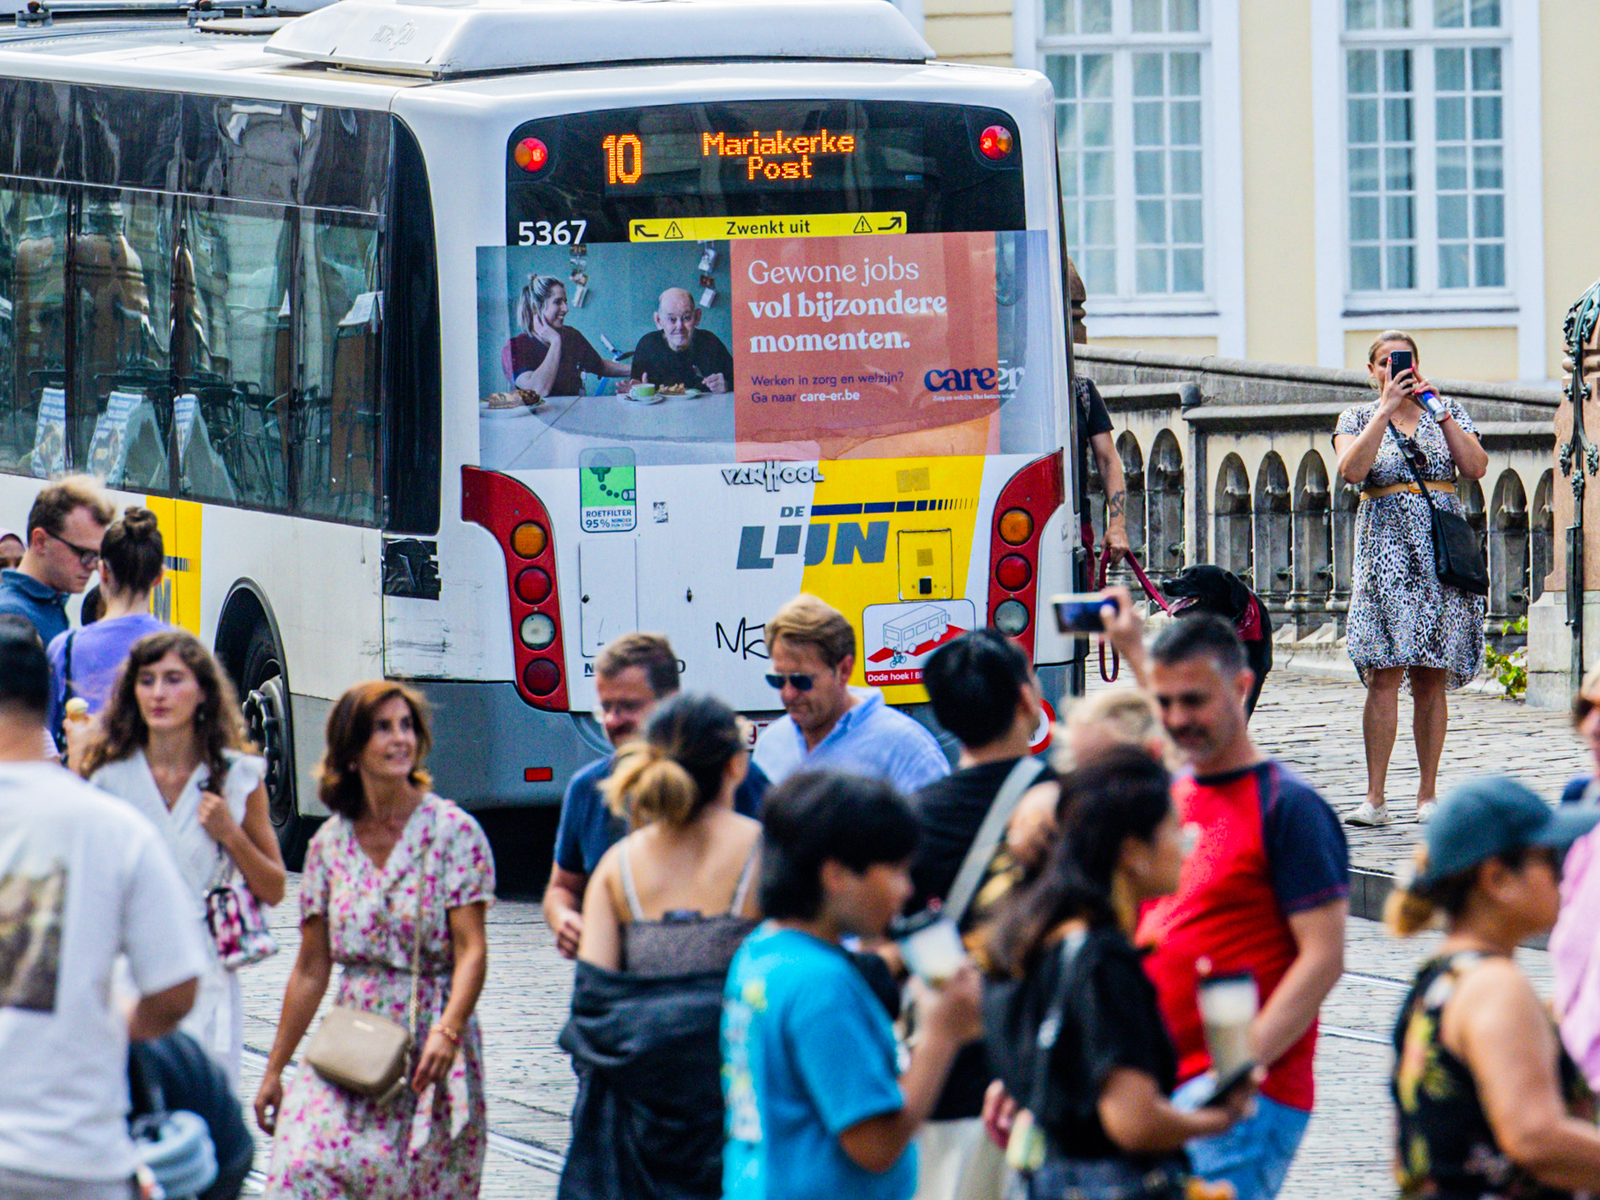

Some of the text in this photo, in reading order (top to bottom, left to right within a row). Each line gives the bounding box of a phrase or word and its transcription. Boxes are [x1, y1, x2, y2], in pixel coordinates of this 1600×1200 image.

[702, 128, 855, 156] Mariakerke
[602, 133, 642, 184] 10
[748, 154, 812, 180] Post
[518, 219, 588, 246] 5367
[726, 219, 810, 236] Zwenkt uit
[748, 255, 920, 287] Gewone jobs
[748, 288, 948, 323] vol bijzondere
[749, 329, 911, 353] momenten.
[751, 371, 904, 387] Werken in zorg en welzijn?
[751, 389, 860, 403] Ga naar care-er.be
[585, 509, 632, 518] ROETFILTER
[780, 506, 805, 518] DE
[736, 521, 890, 570] LIJN
[867, 673, 889, 682] Dode
